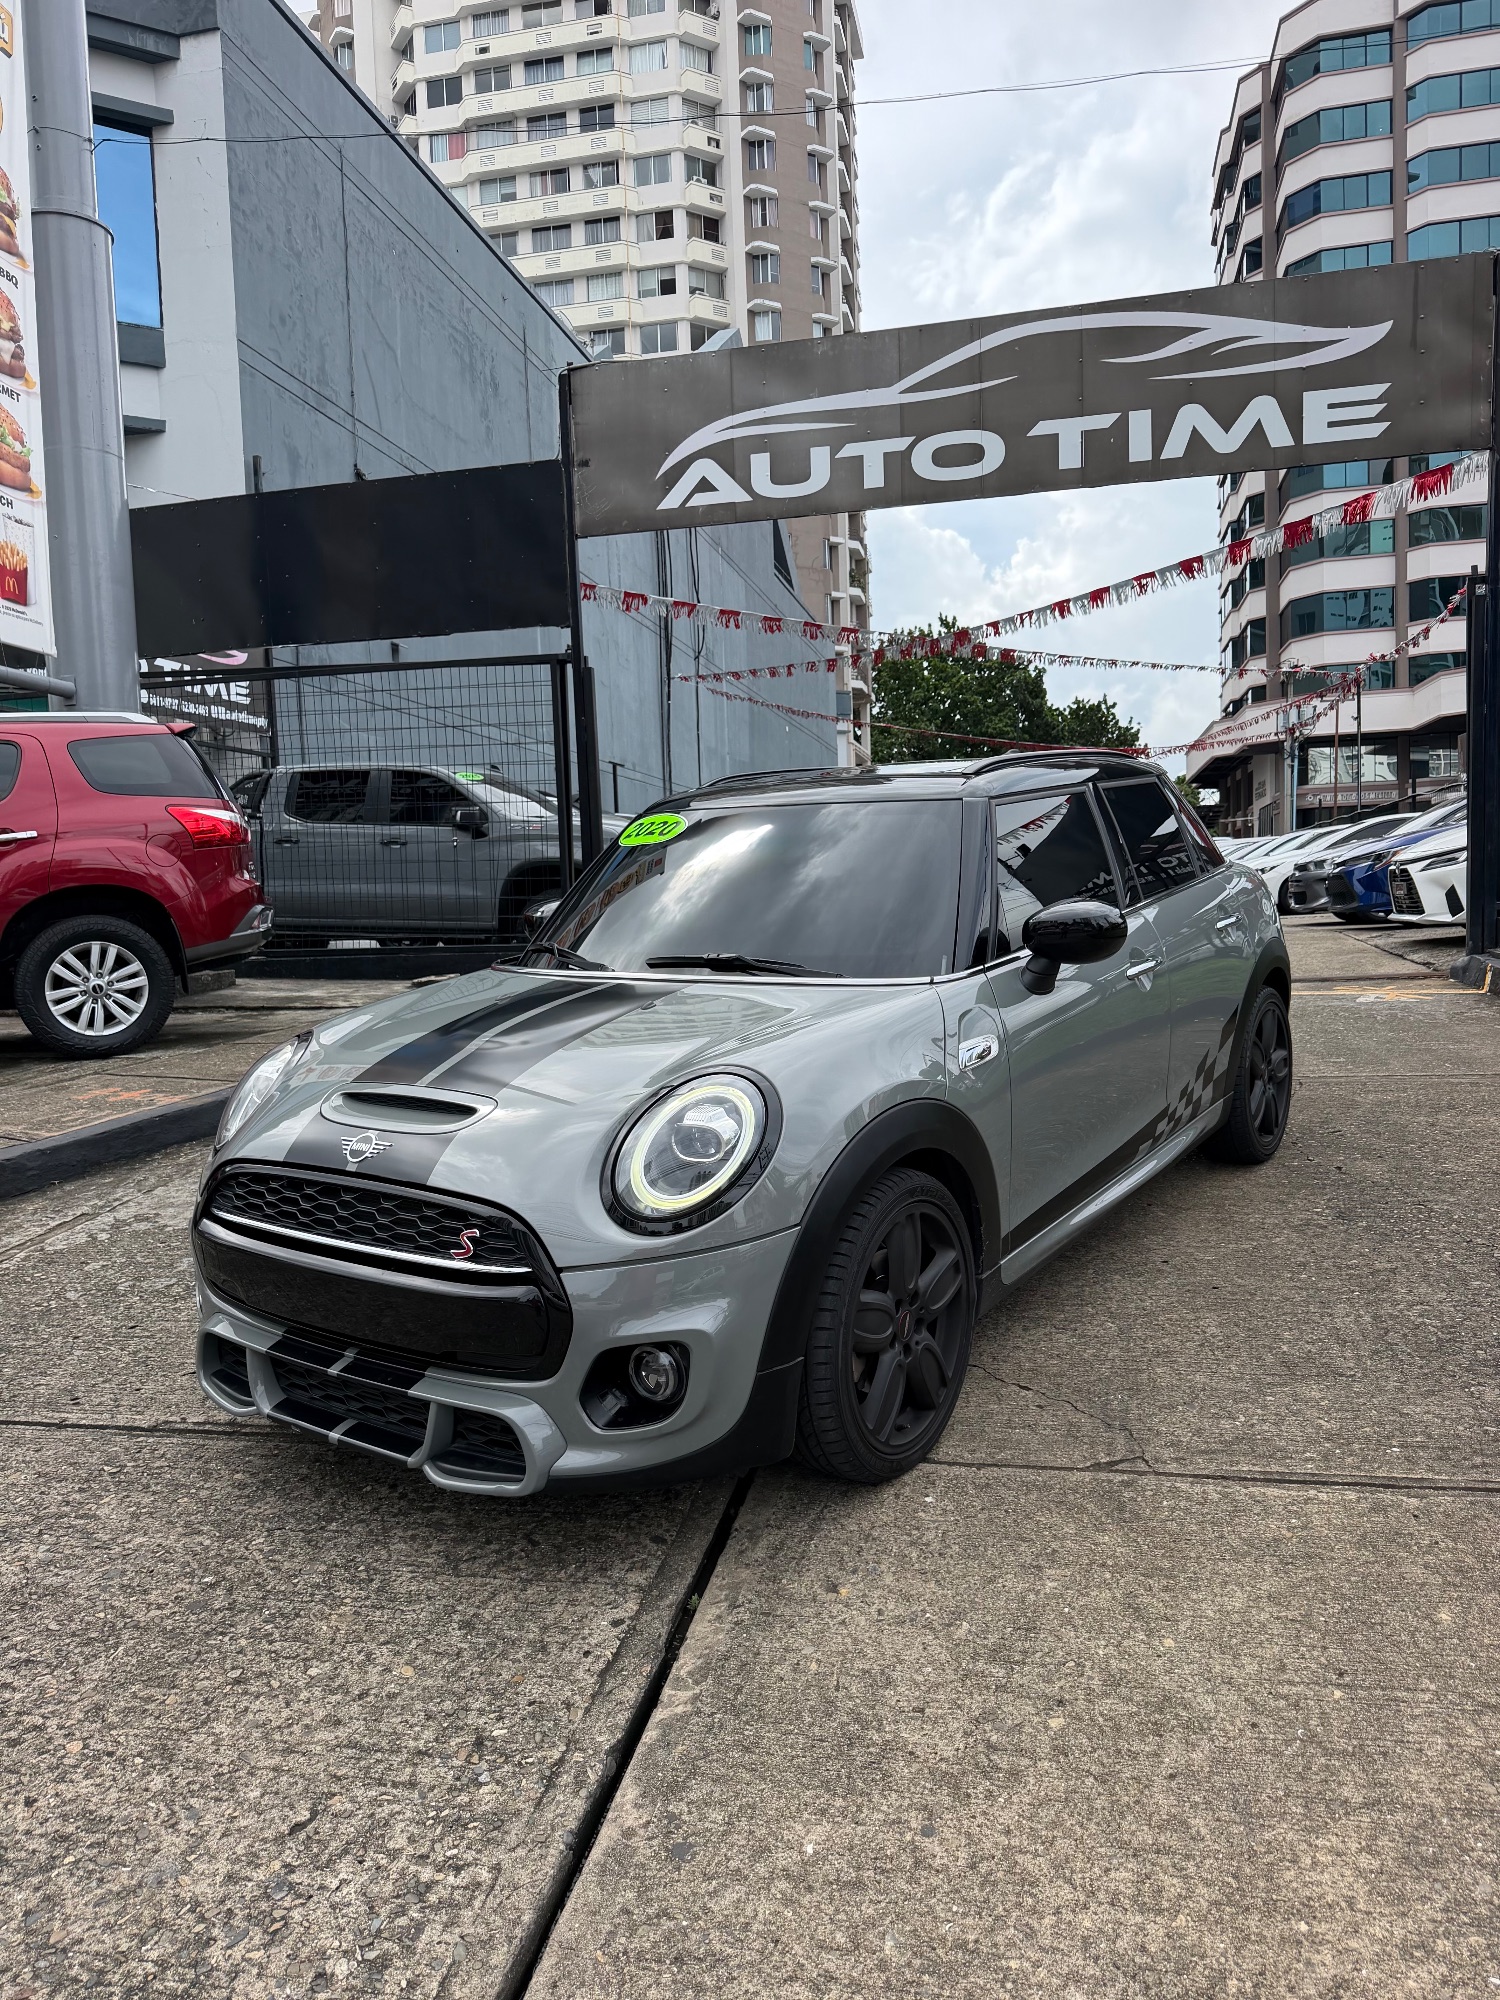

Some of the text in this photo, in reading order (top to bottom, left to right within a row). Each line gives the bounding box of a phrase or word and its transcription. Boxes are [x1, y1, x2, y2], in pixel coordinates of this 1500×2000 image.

[0, 384, 21, 403] MET
[657, 382, 1392, 510] AUTO TIME
[622, 820, 681, 840] 2020
[351, 1142, 371, 1152] MINI
[450, 1229, 480, 1260] S
